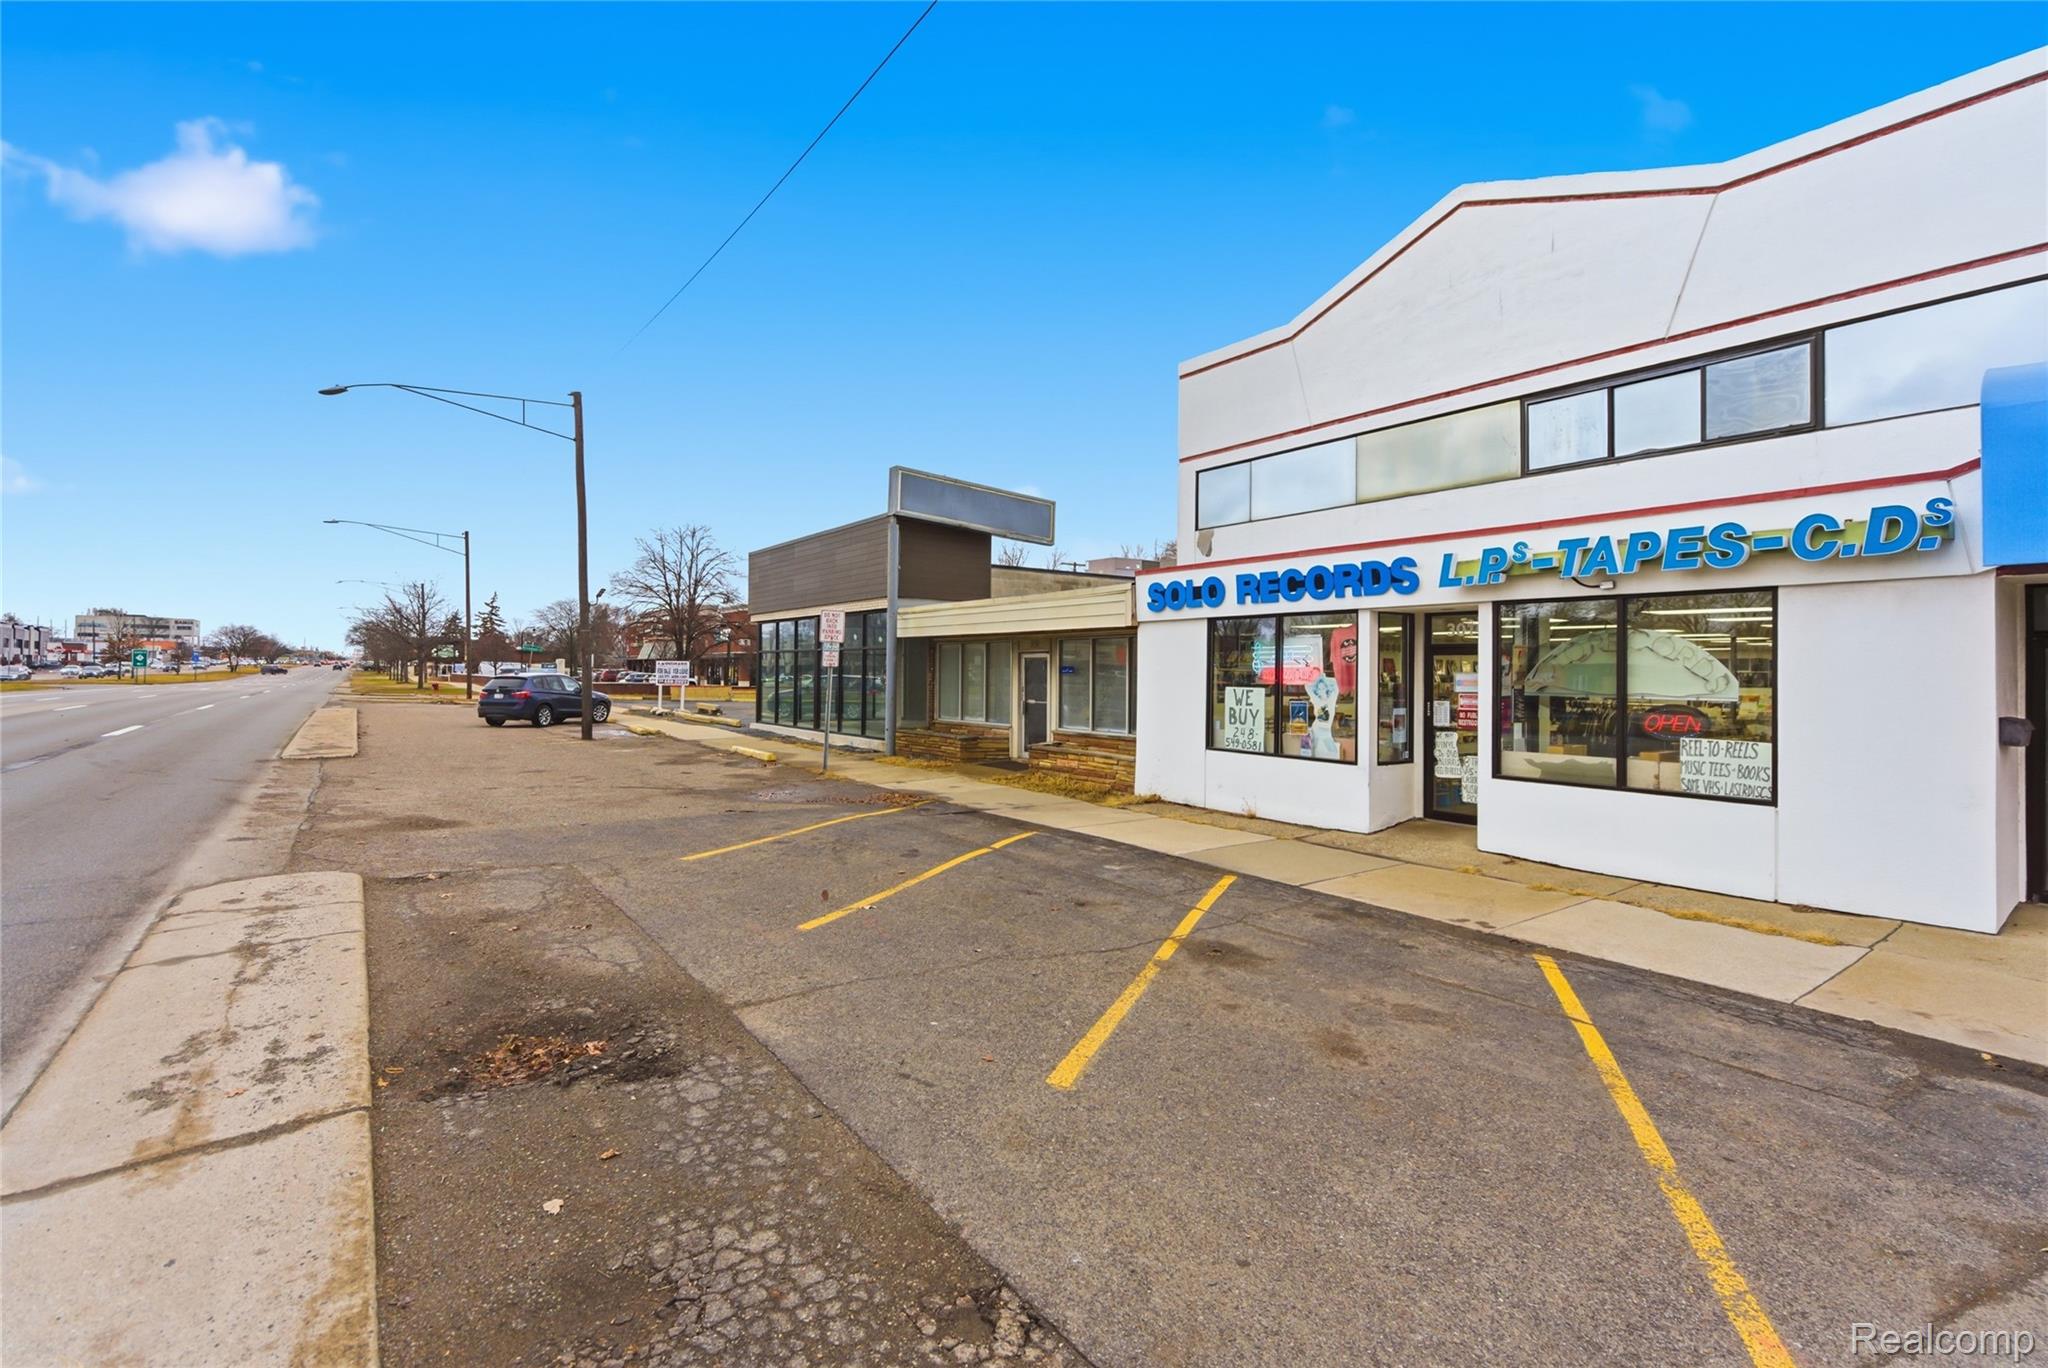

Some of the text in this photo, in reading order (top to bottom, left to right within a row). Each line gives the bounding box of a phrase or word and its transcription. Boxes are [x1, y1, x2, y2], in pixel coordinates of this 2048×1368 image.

[1147, 576, 1226, 612] SOLO
[1236, 556, 1420, 606] RECORDS
[1233, 688, 1253, 707] WE
[1228, 706, 1260, 727] BUY
[1644, 714, 1701, 733] OPEN
